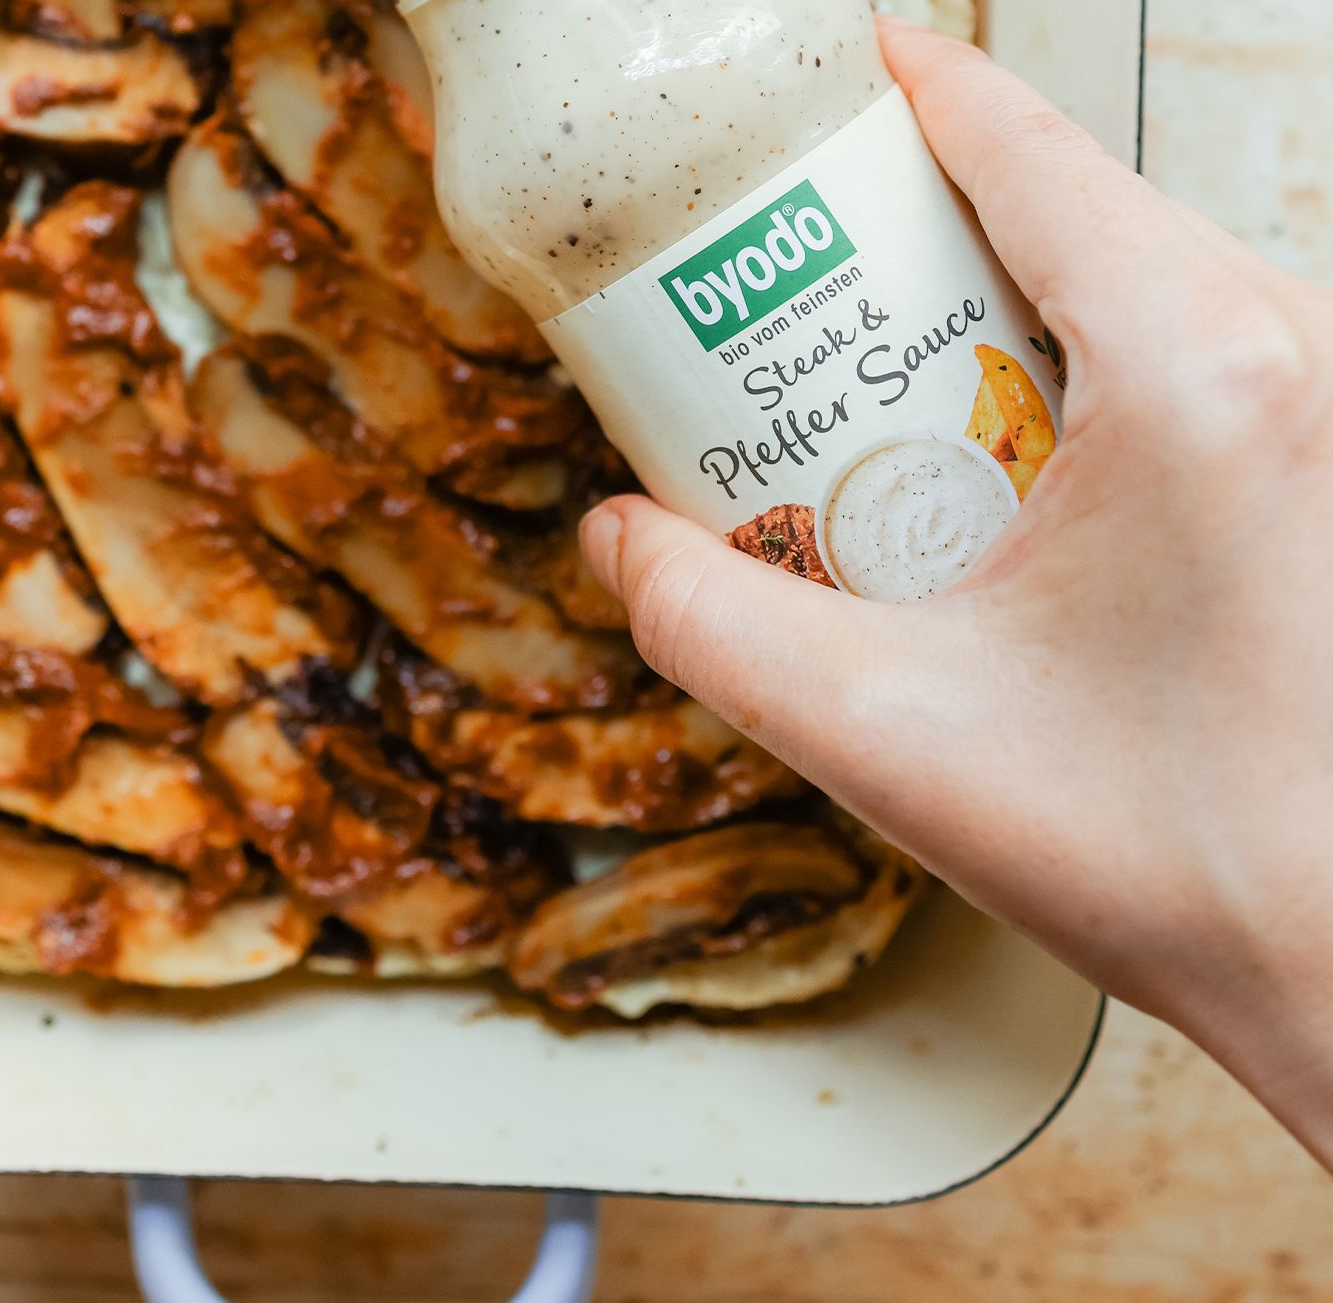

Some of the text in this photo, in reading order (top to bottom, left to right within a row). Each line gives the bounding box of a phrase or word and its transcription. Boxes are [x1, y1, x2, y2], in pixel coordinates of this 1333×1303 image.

[718, 265, 863, 366] bio vom feinsten
[743, 298, 889, 411] Steak &
[699, 297, 985, 499] Pfeffer Sauce
